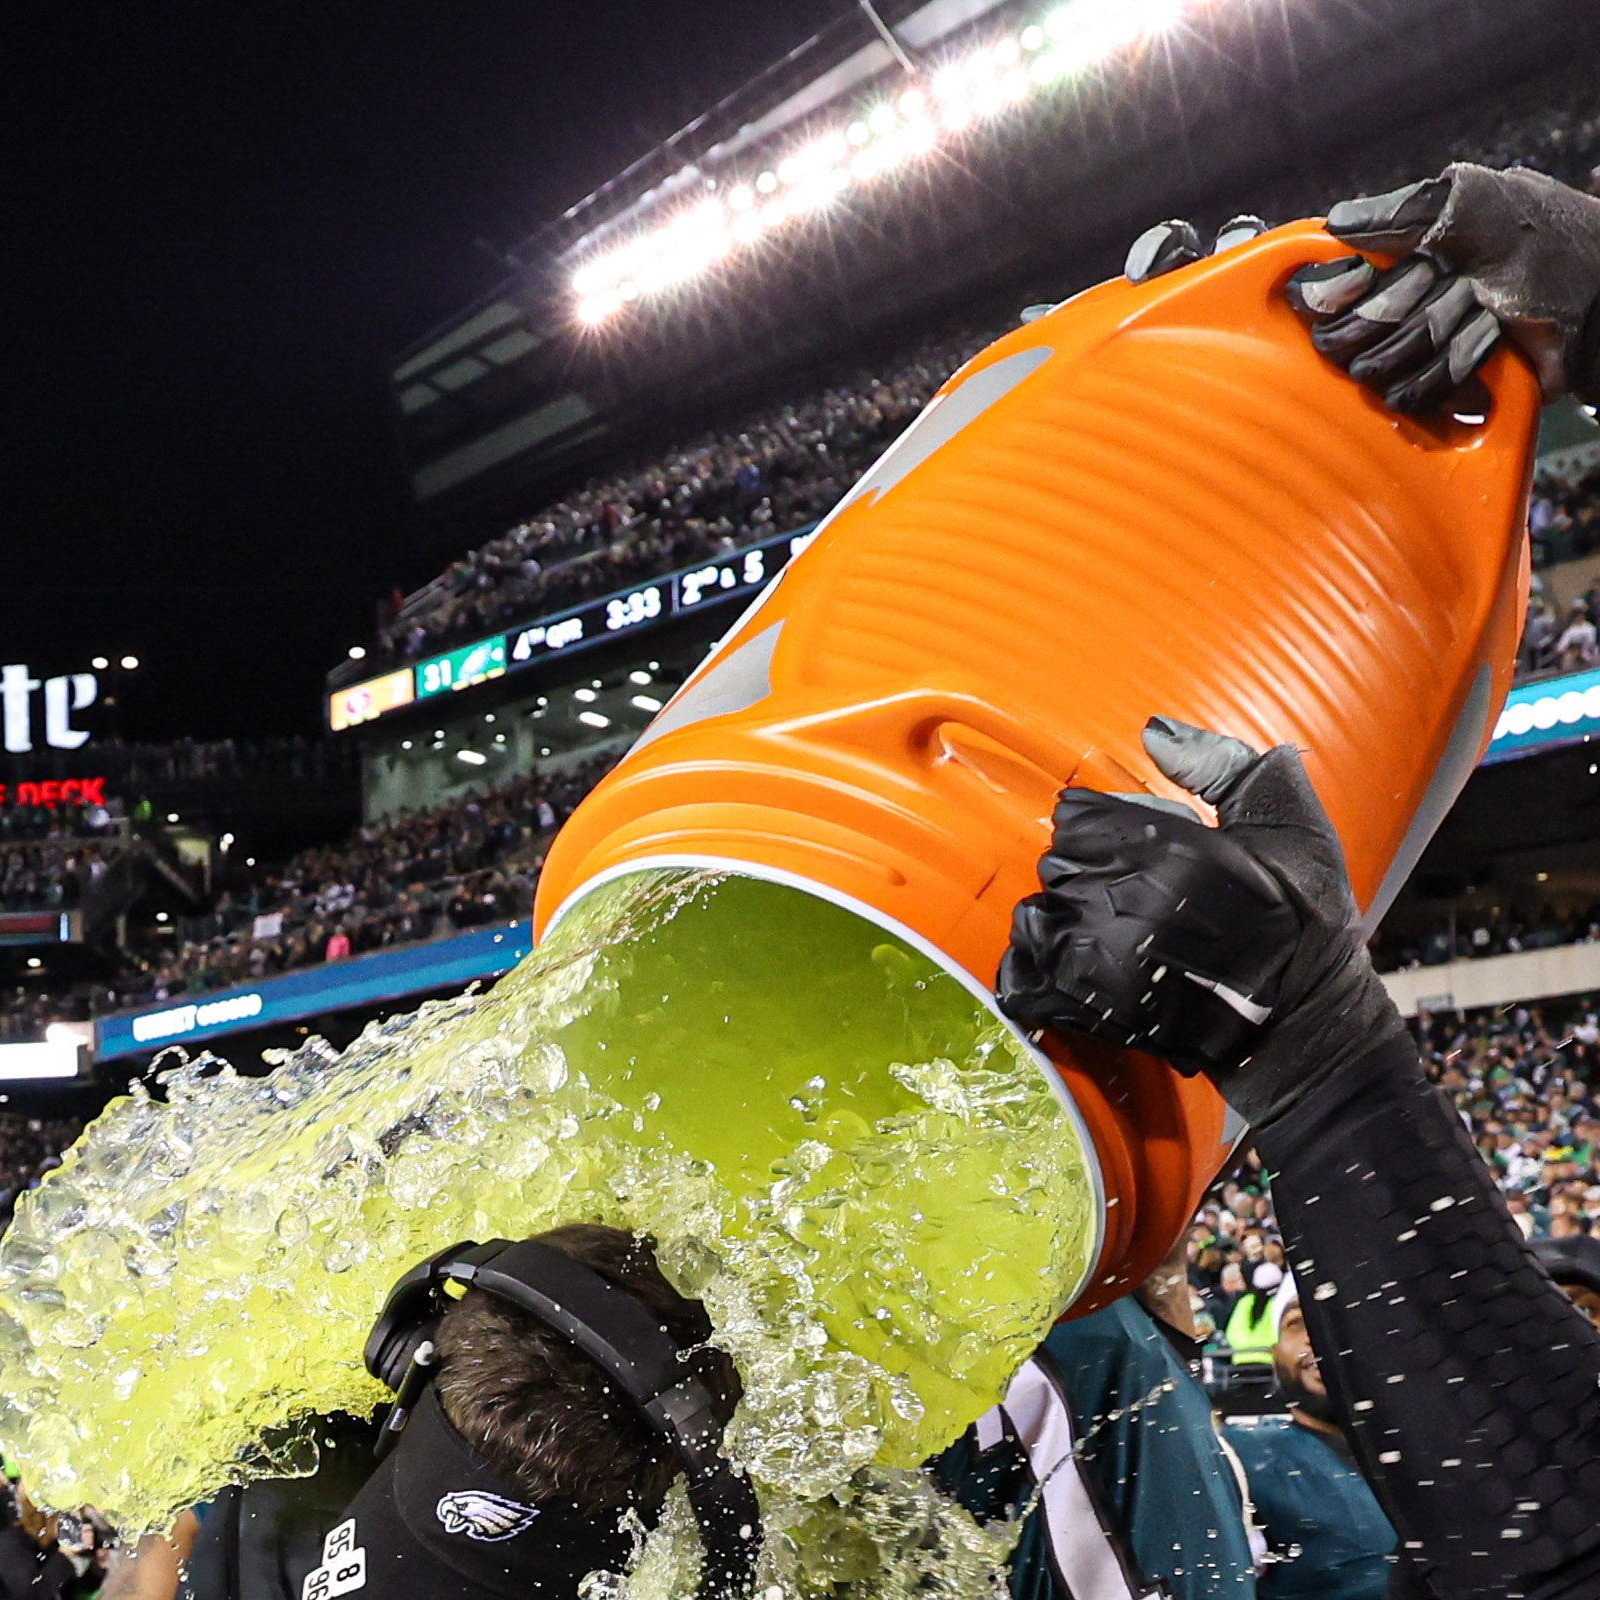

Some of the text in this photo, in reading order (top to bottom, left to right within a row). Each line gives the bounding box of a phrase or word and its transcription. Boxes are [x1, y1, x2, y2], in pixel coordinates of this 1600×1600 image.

[743, 550, 765, 584] 5
[606, 587, 662, 631] 3:33
[422, 659, 453, 693] 31
[327, 1526, 351, 1560] 95
[336, 1562, 361, 1582] 8
